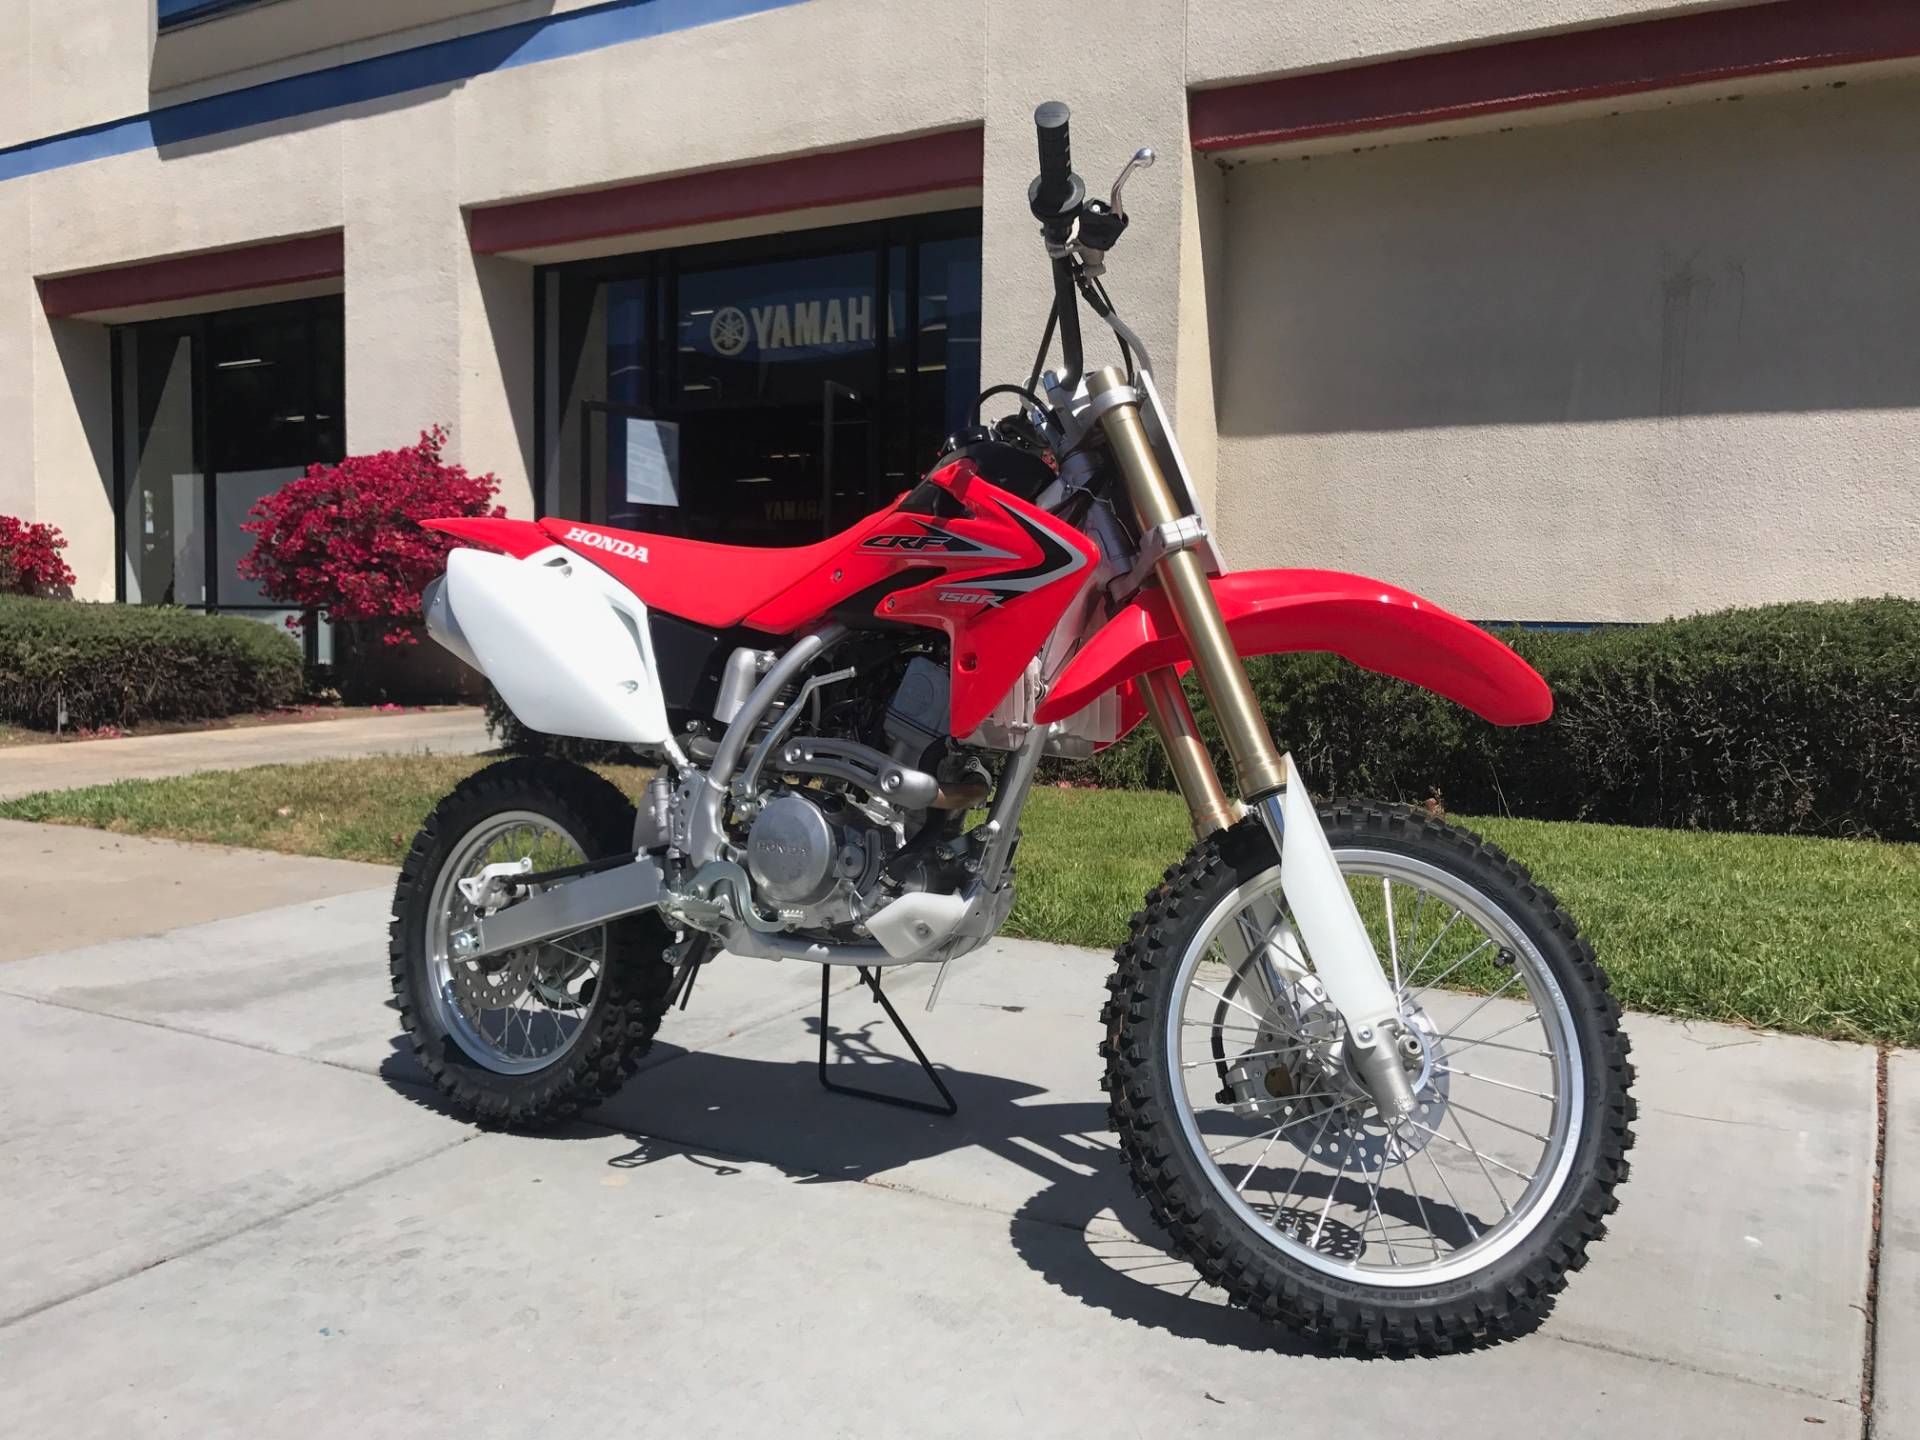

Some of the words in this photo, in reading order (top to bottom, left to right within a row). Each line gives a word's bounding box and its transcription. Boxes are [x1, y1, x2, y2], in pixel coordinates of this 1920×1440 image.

[563, 527, 649, 563] HONDA
[860, 535, 953, 551] CRF
[938, 591, 1005, 609] 150R
